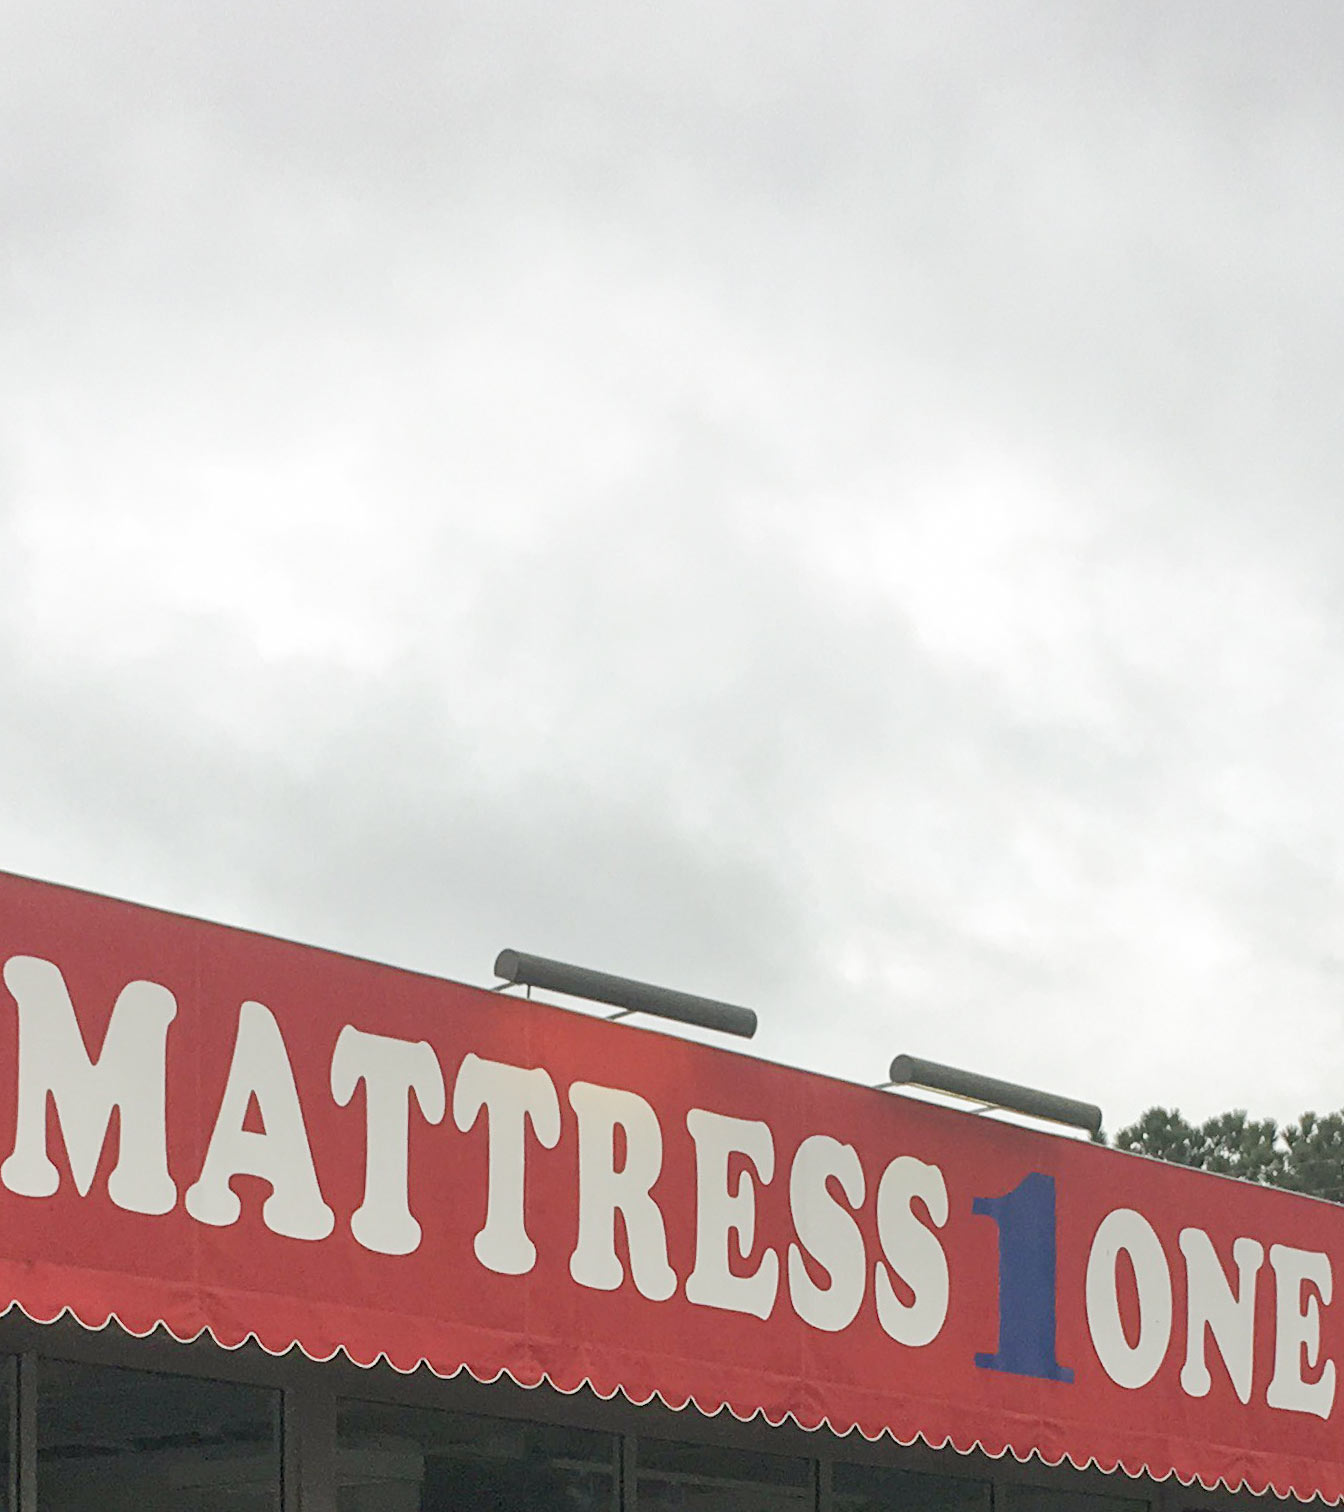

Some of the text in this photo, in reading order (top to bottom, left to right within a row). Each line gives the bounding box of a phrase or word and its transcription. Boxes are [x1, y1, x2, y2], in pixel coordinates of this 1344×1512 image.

[1, 955, 1335, 1420] MATTRESS 1 ONE
